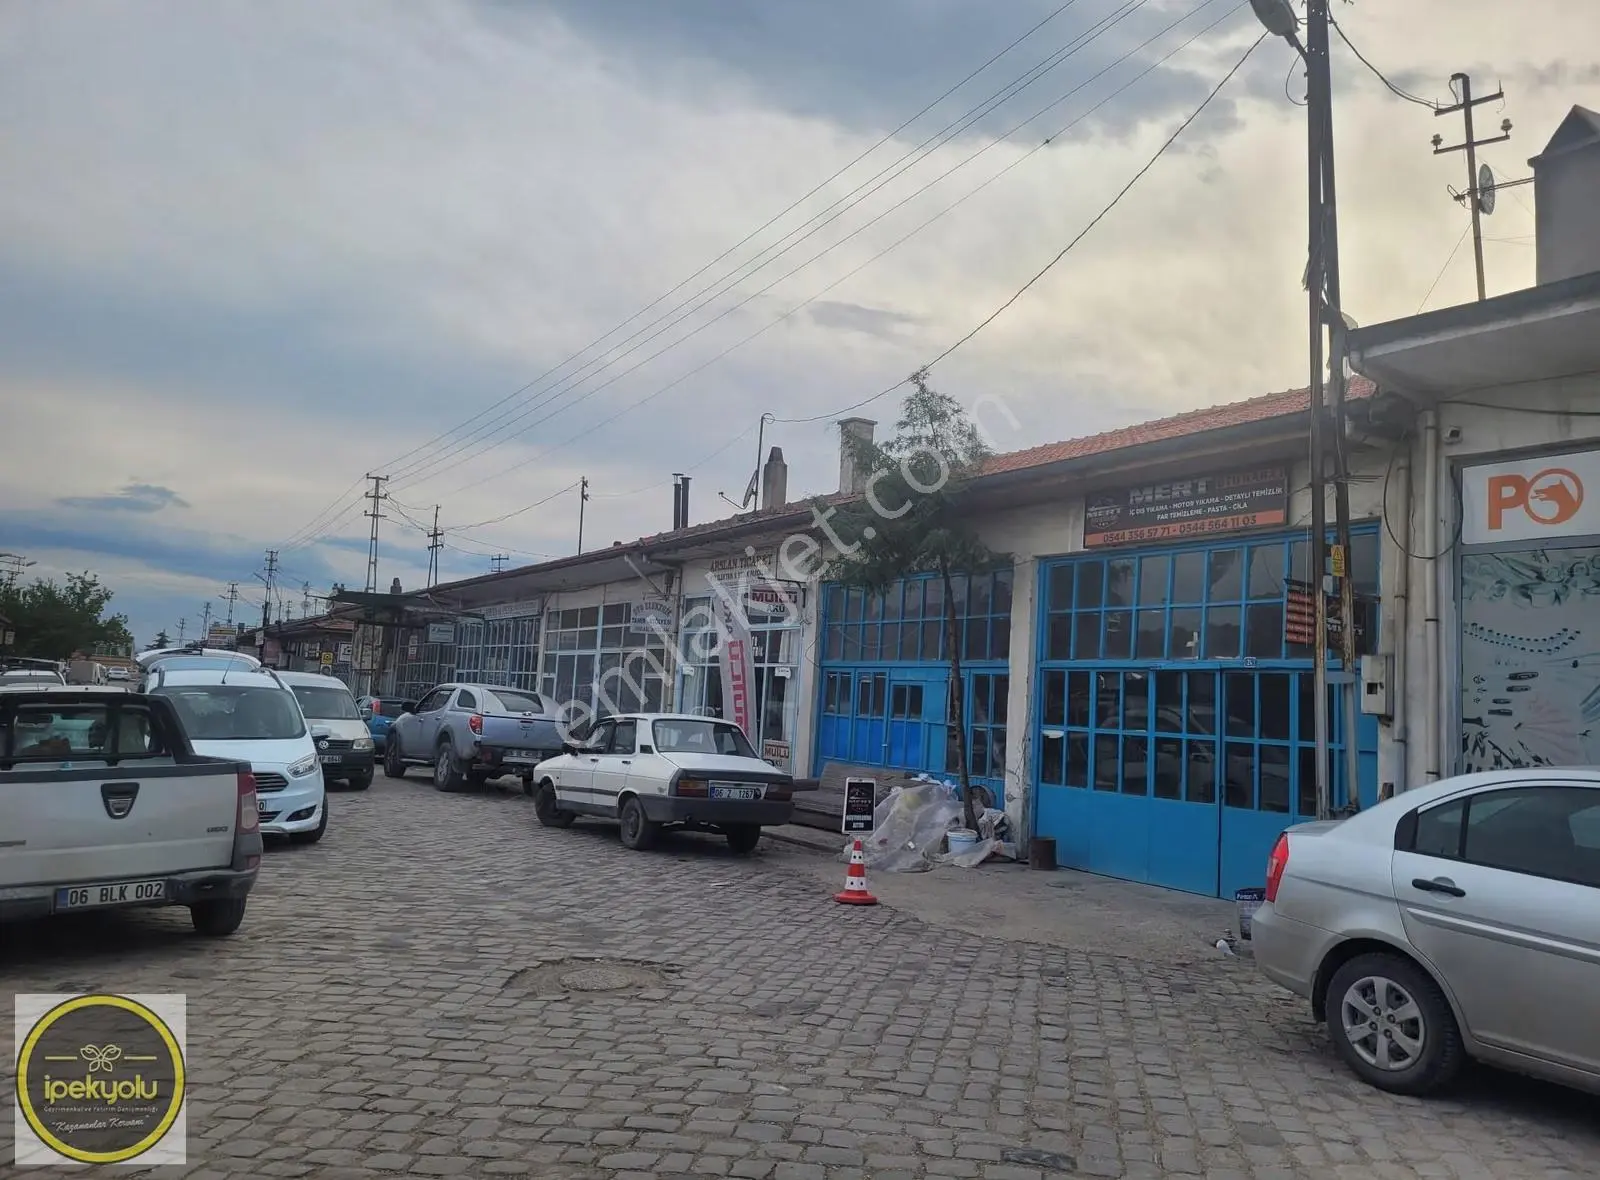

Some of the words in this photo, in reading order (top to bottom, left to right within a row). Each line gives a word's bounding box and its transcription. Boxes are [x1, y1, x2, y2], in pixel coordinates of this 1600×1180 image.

[1129, 477, 1213, 505] MERT
[1172, 500, 1194, 509] MOTOR
[1207, 505, 1227, 514] PASTA
[1103, 531, 1126, 543] 0544
[1179, 520, 1205, 533] 0544
[70, 889, 89, 905] 06
[100, 885, 128, 903] BLK
[135, 883, 163, 899] 002
